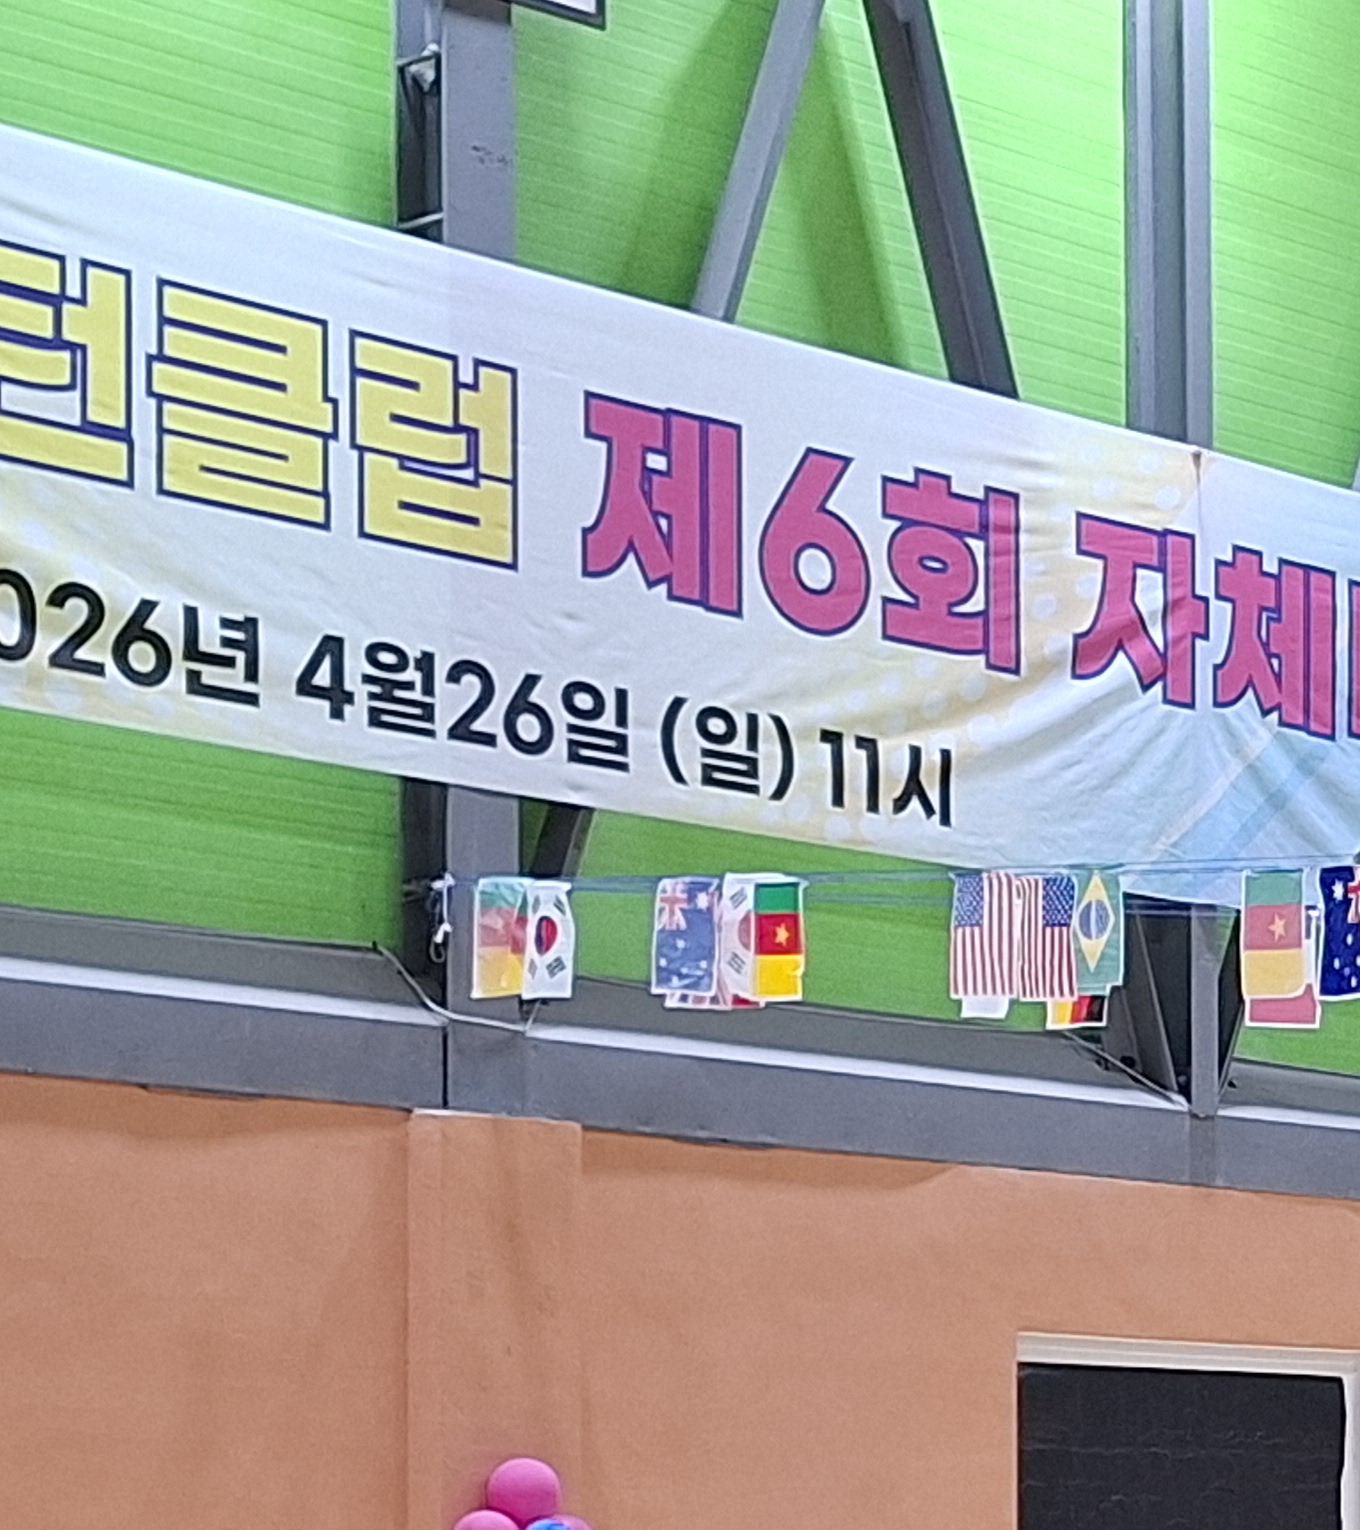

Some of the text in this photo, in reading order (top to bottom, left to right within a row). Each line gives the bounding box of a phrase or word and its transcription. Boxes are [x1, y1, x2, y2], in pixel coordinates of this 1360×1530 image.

[0, 238, 519, 571] 턴클럽
[581, 389, 1021, 677] 제6회
[295, 633, 630, 773] 4월26일
[658, 695, 795, 801] (일)
[819, 728, 953, 828] 11시
